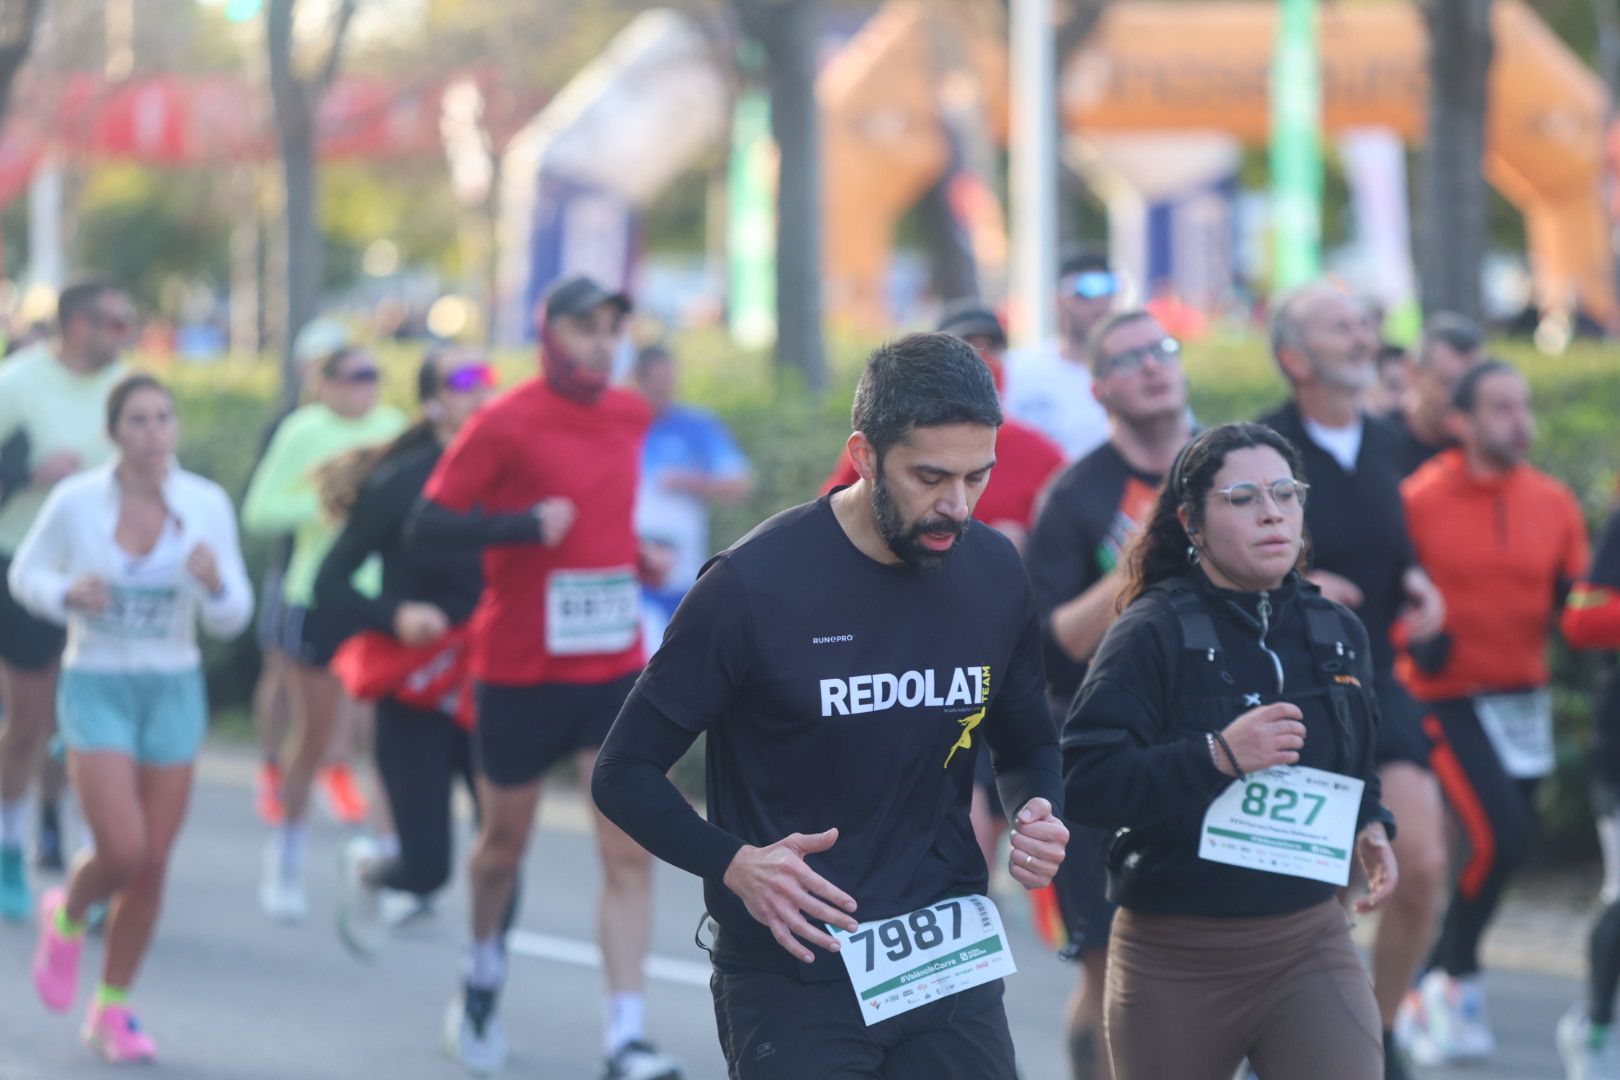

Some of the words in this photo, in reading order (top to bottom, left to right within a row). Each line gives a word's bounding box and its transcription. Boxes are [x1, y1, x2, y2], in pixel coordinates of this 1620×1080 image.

[820, 666, 983, 717] REDOLAT
[981, 665, 991, 703] TEAM
[1241, 782, 1328, 827] 827
[849, 901, 962, 973] 7987
